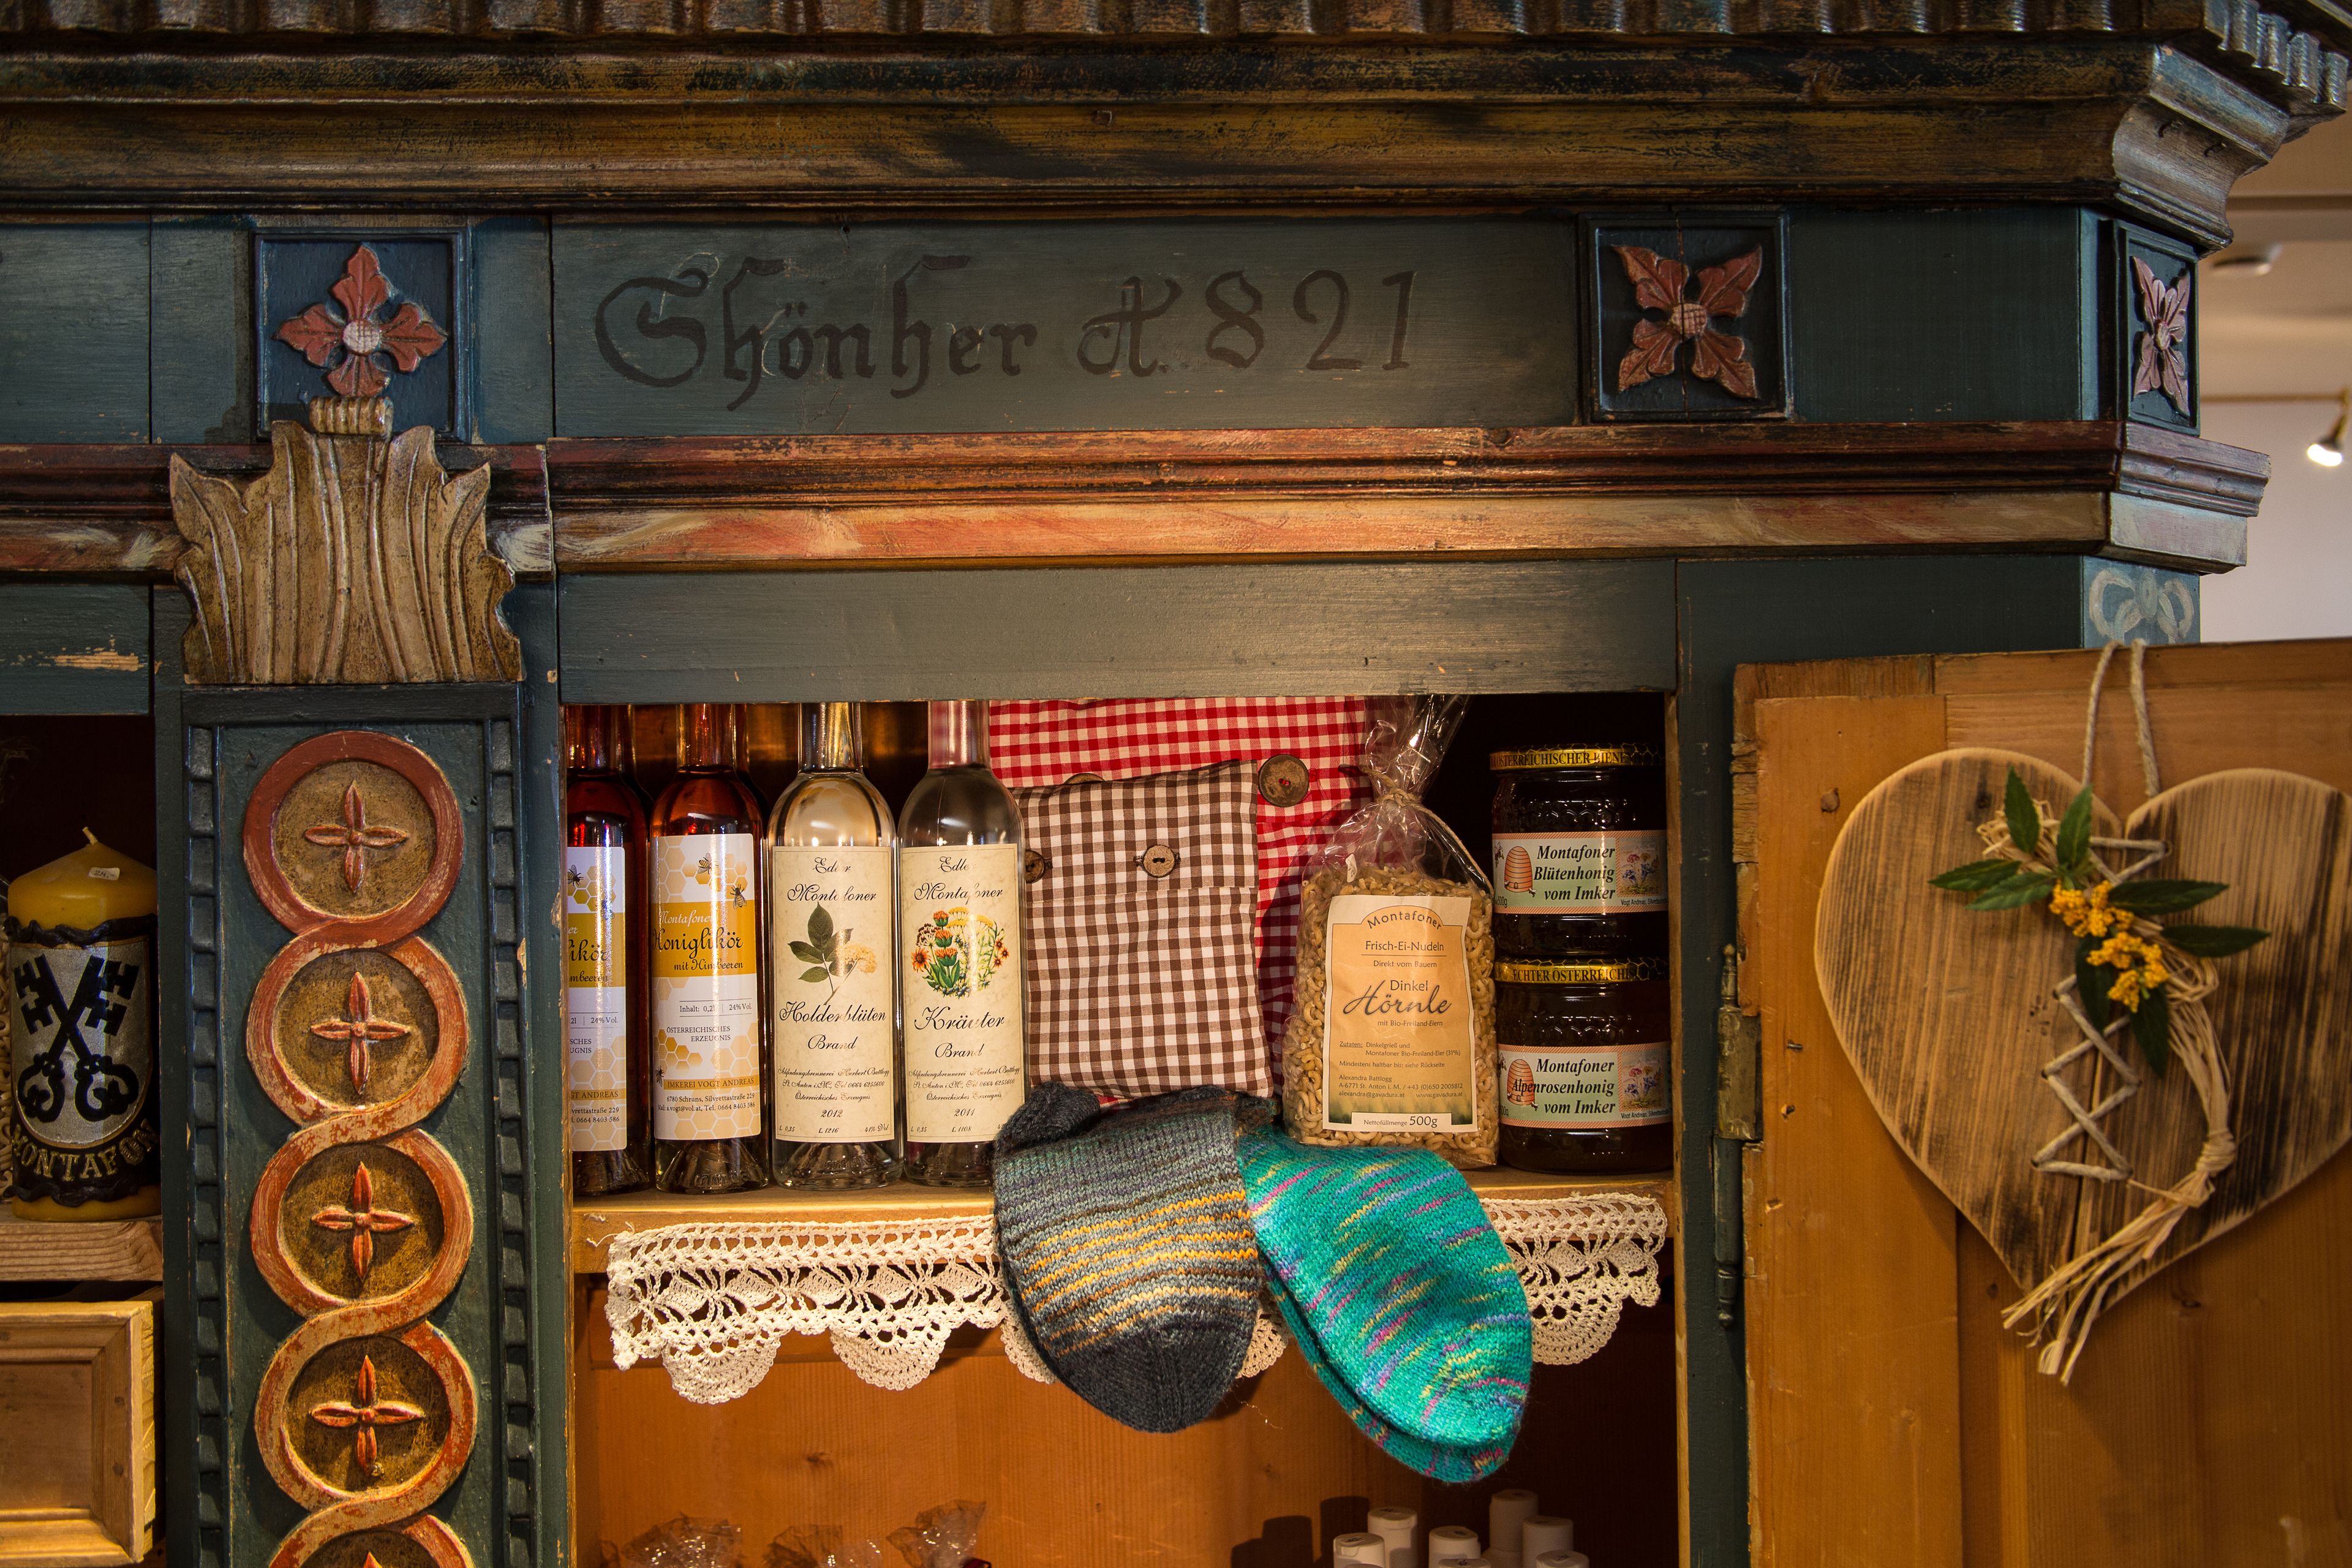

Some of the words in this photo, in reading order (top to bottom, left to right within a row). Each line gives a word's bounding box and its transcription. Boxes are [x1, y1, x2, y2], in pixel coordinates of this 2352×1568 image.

[1537, 845, 1616, 862] Montafoner
[812, 857, 852, 873] Edlr
[938, 856, 976, 873] Edle
[1534, 865, 1615, 883] Blütenhonig
[1544, 890, 1570, 901] vom
[1574, 885, 1616, 900] Imker
[659, 910, 716, 927] Montafone
[1367, 911, 1442, 930] Montafoner
[652, 927, 744, 959] Honiglikör
[1365, 940, 1444, 951] Frisch-Ei-Nudeln
[1513, 969, 1550, 982] ECHTER
[1390, 980, 1428, 992] Dinkel
[1343, 979, 1452, 1016] Hörnle
[914, 1006, 1005, 1030] Kräuter
[808, 1034, 859, 1050] Brand
[935, 1042, 985, 1058] Brand
[1366, 1042, 1398, 1050] Dinkelgrieß
[1536, 1059, 1615, 1077] Montafoner
[722, 1077, 755, 1087] ANDREAS
[792, 1080, 813, 1088] Anton
[921, 1080, 944, 1089] Anton
[1512, 1079, 1615, 1097] Alpenrosenhonig
[581, 1091, 619, 1099] ANDREAS
[679, 1095, 704, 1103] Schruns,
[820, 1109, 844, 1118] 2012
[954, 1107, 976, 1117] 2011
[1544, 1103, 1570, 1114] vom
[1574, 1099, 1616, 1114] Imker
[1409, 1115, 1438, 1128] 500g
